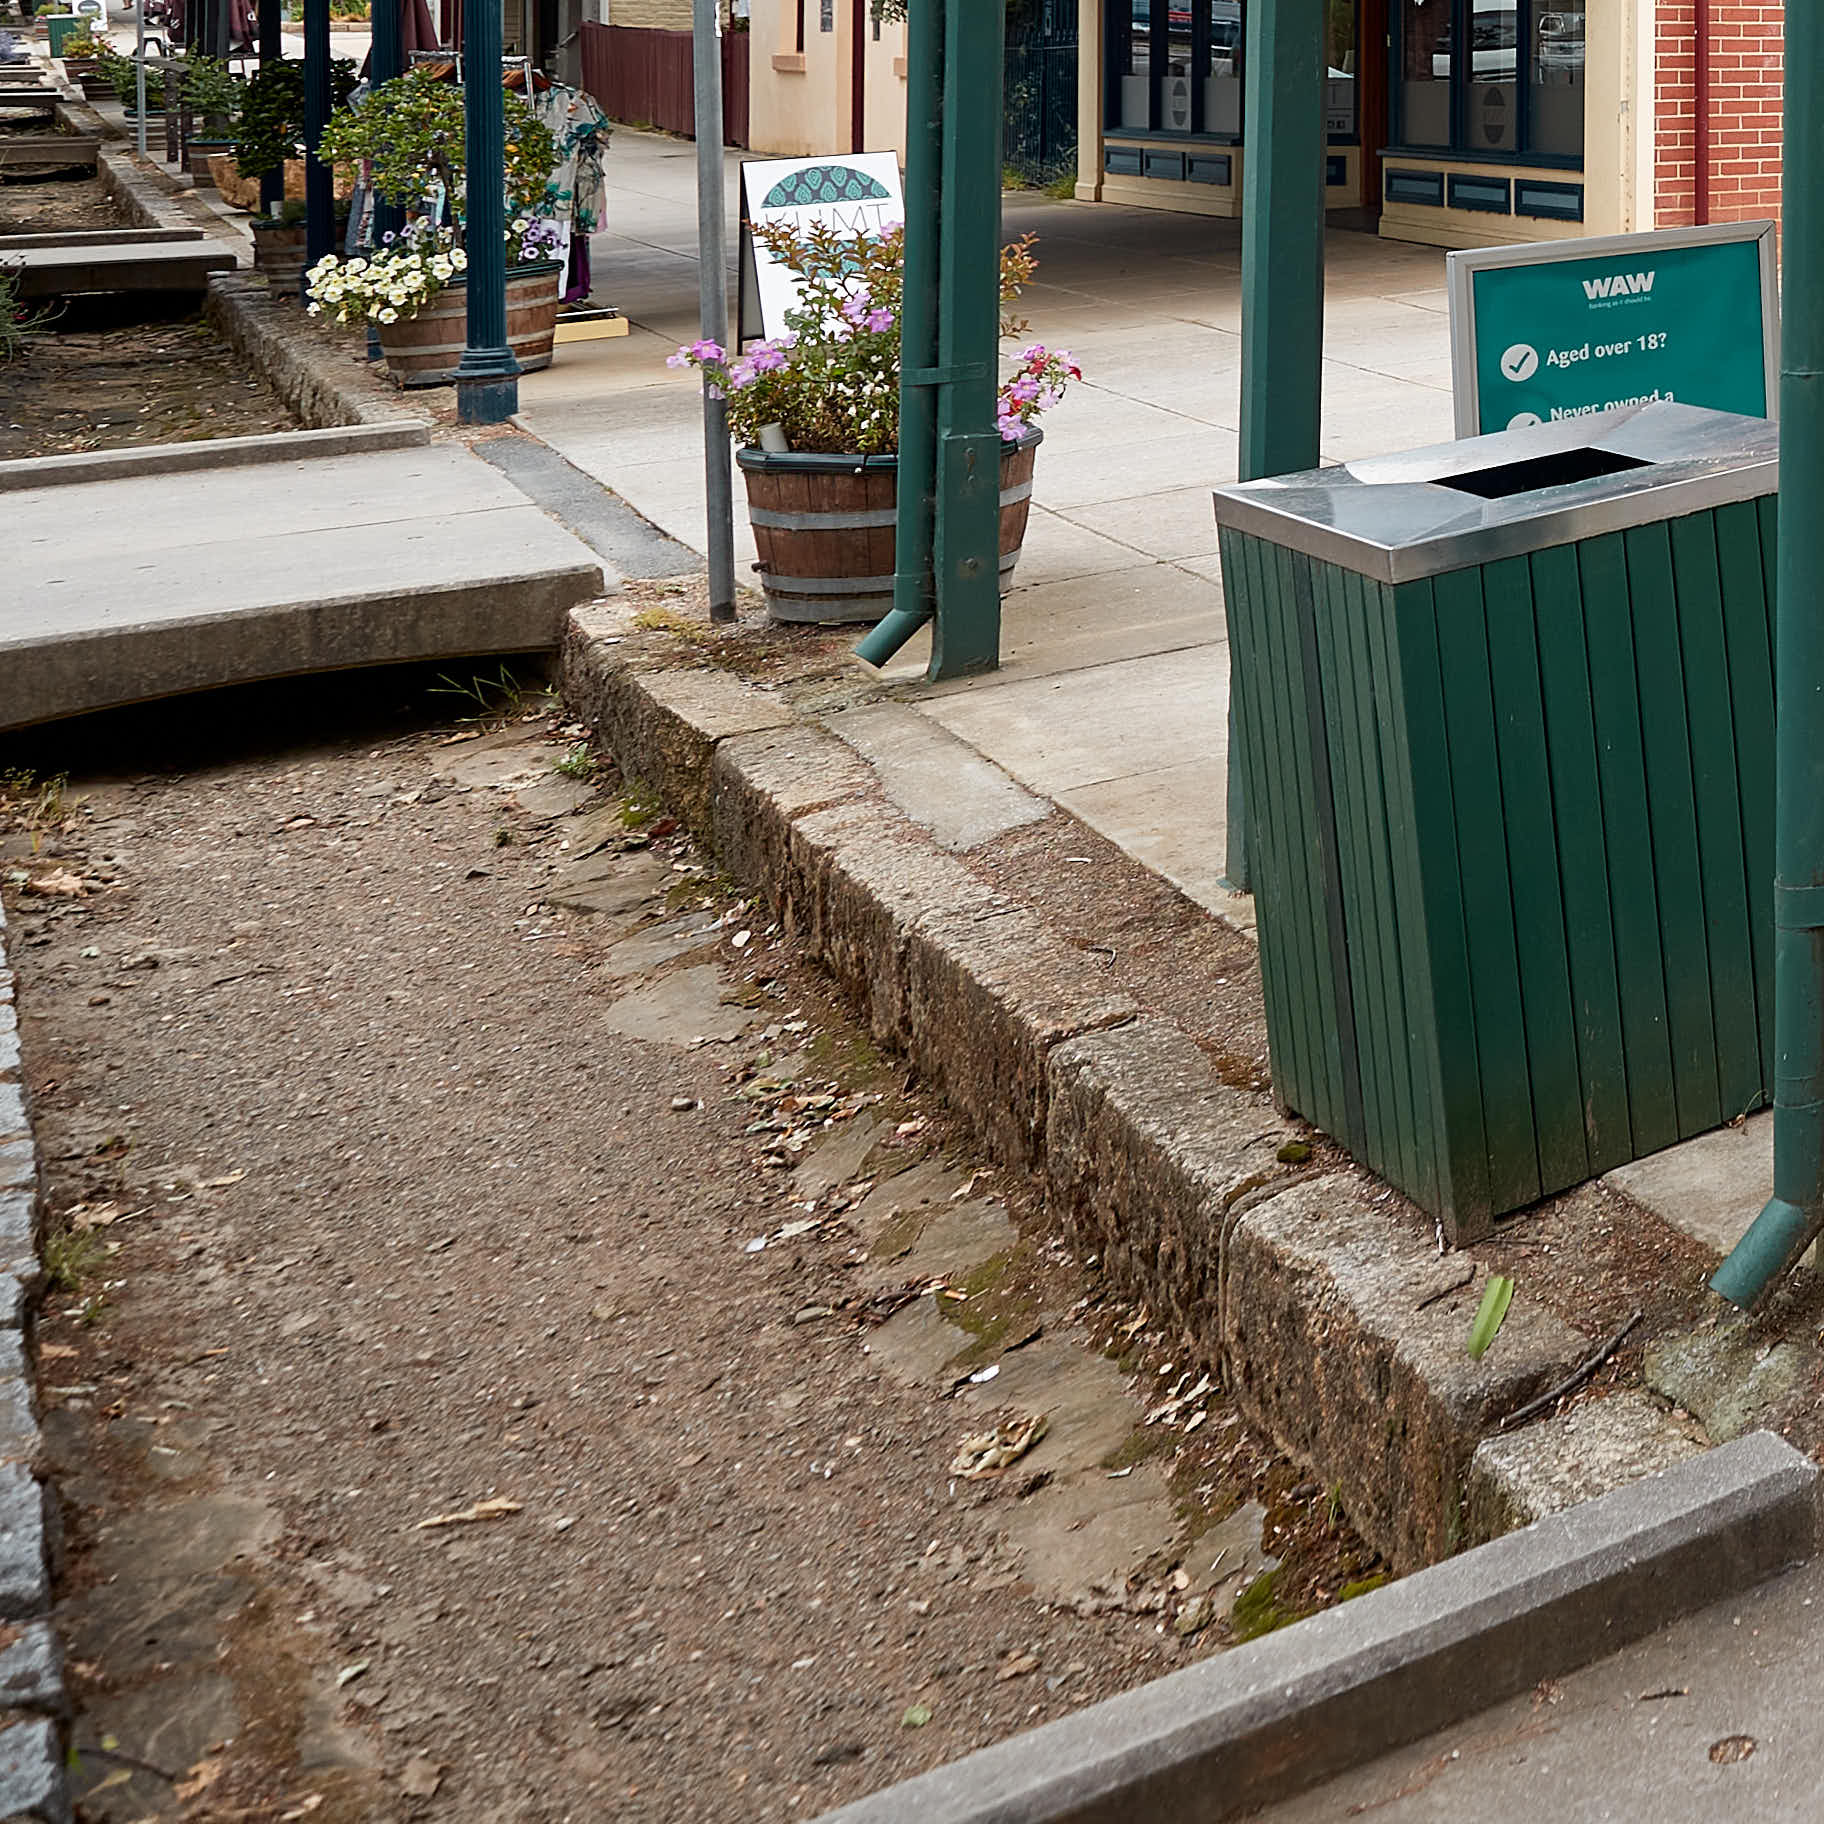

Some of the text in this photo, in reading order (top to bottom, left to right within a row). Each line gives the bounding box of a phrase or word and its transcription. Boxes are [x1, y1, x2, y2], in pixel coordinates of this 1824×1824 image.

[1582, 271, 1655, 300] WAW
[1546, 332, 1667, 369] Aged over 18?
[1549, 404, 1599, 423] Never
[1603, 389, 1660, 413] owned
